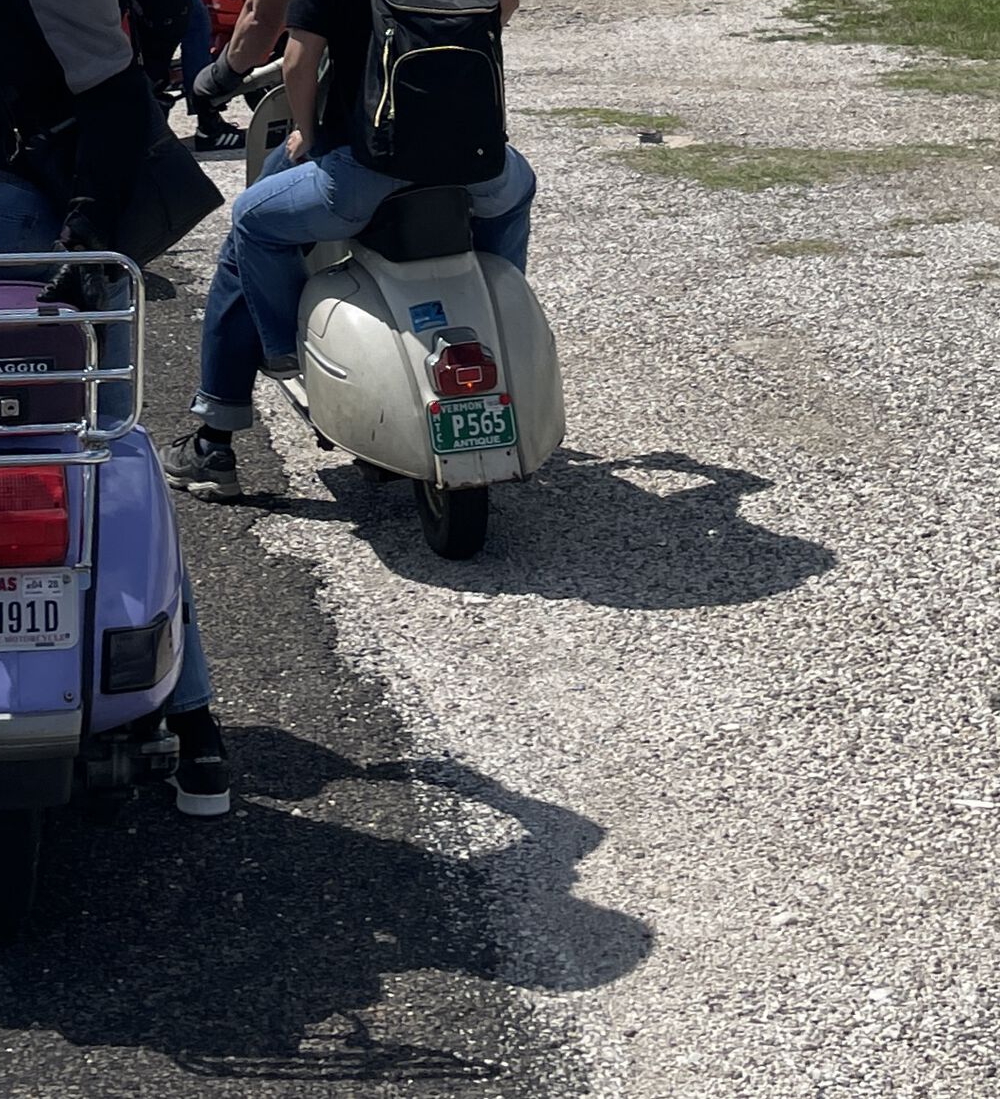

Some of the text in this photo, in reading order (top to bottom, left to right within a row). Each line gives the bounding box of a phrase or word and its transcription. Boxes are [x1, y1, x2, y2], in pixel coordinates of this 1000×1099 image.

[440, 401, 485, 414] VERMON
[452, 410, 506, 438] P565
[453, 435, 501, 448] ANTIQUE
